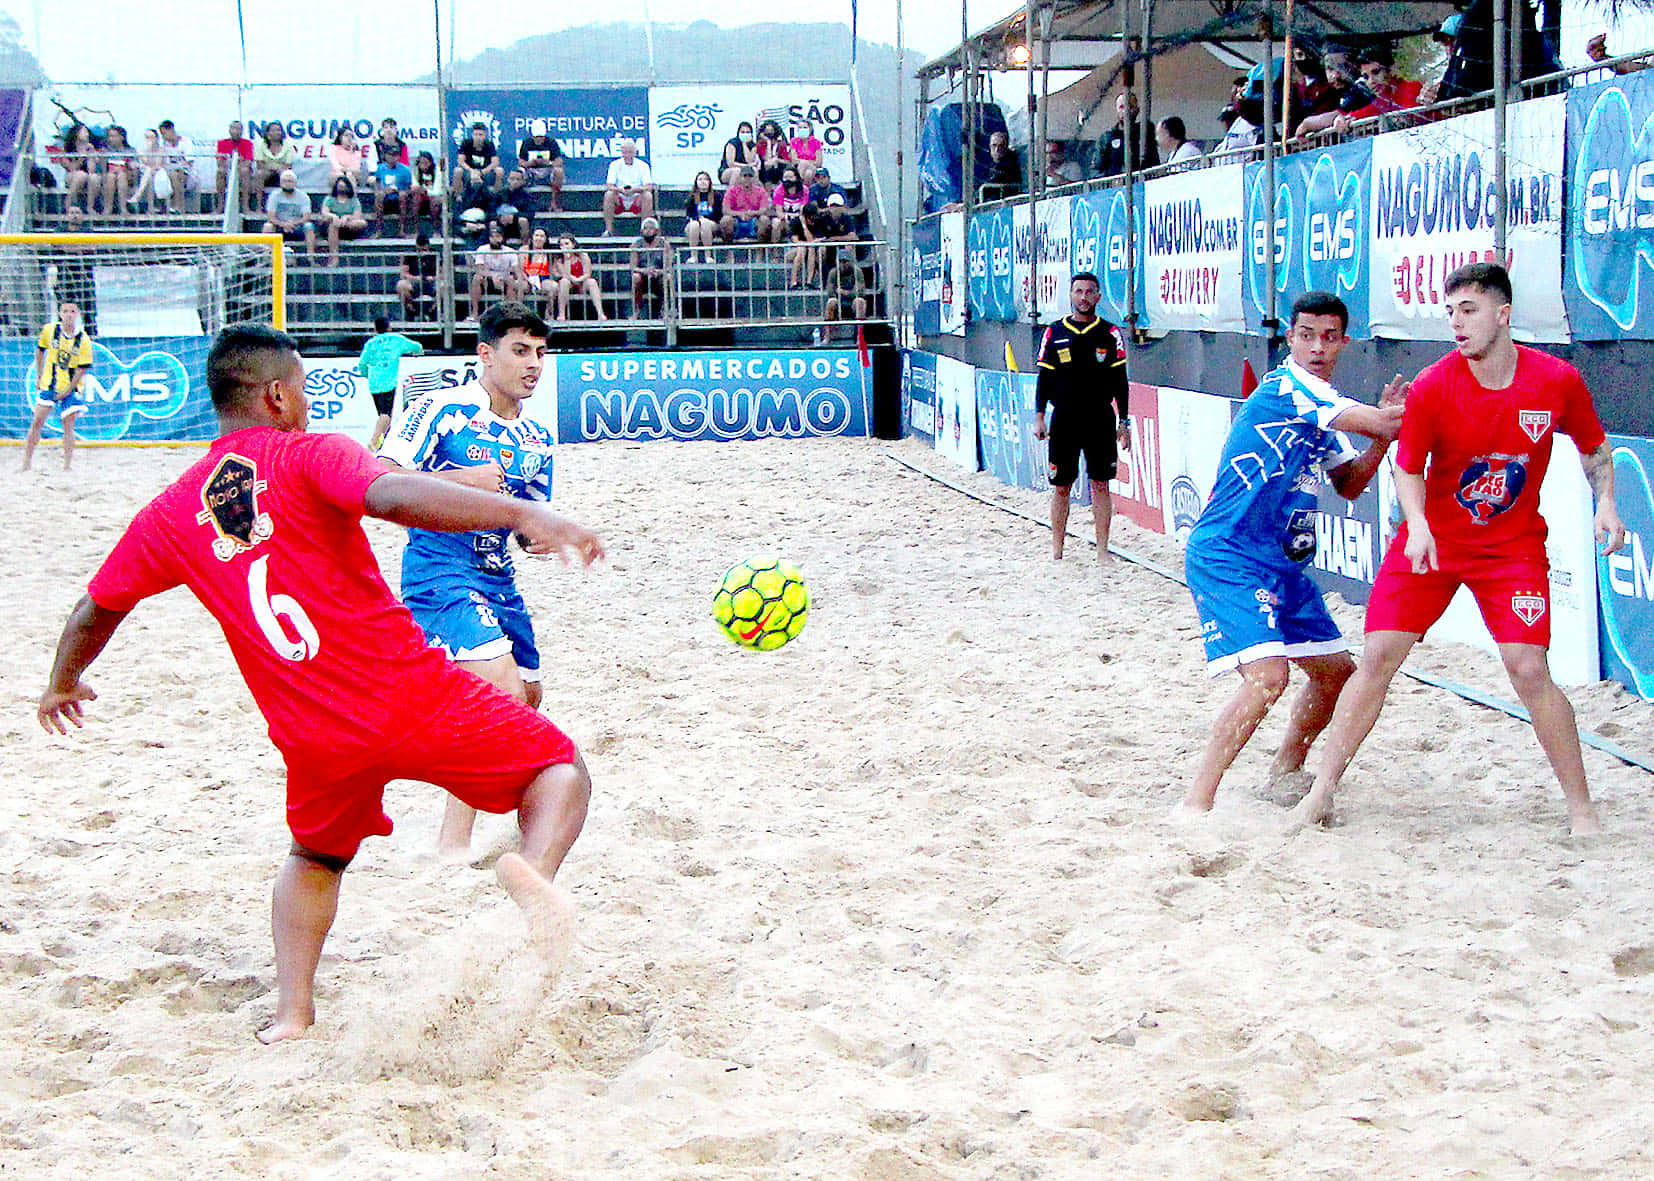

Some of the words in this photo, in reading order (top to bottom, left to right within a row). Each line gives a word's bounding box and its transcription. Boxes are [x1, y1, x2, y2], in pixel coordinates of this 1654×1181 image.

[515, 116, 618, 132] PRFEITURA
[622, 116, 645, 131] DE
[788, 98, 845, 124] SÃO
[515, 132, 646, 159] INHAÉM
[677, 132, 705, 148] SP
[1377, 151, 1550, 240] NAGUMO.CM.BR
[1149, 198, 1238, 256] NAGUMO.COM.BR
[1309, 208, 1355, 262] EMS
[1160, 267, 1219, 304] DELIVERY
[441, 361, 478, 387] SÃ
[580, 358, 851, 382] SUPERMERCADOS
[85, 373, 170, 402] MS
[310, 401, 344, 420] SP
[580, 387, 851, 440] NAGUMO
[247, 553, 321, 662] 6
